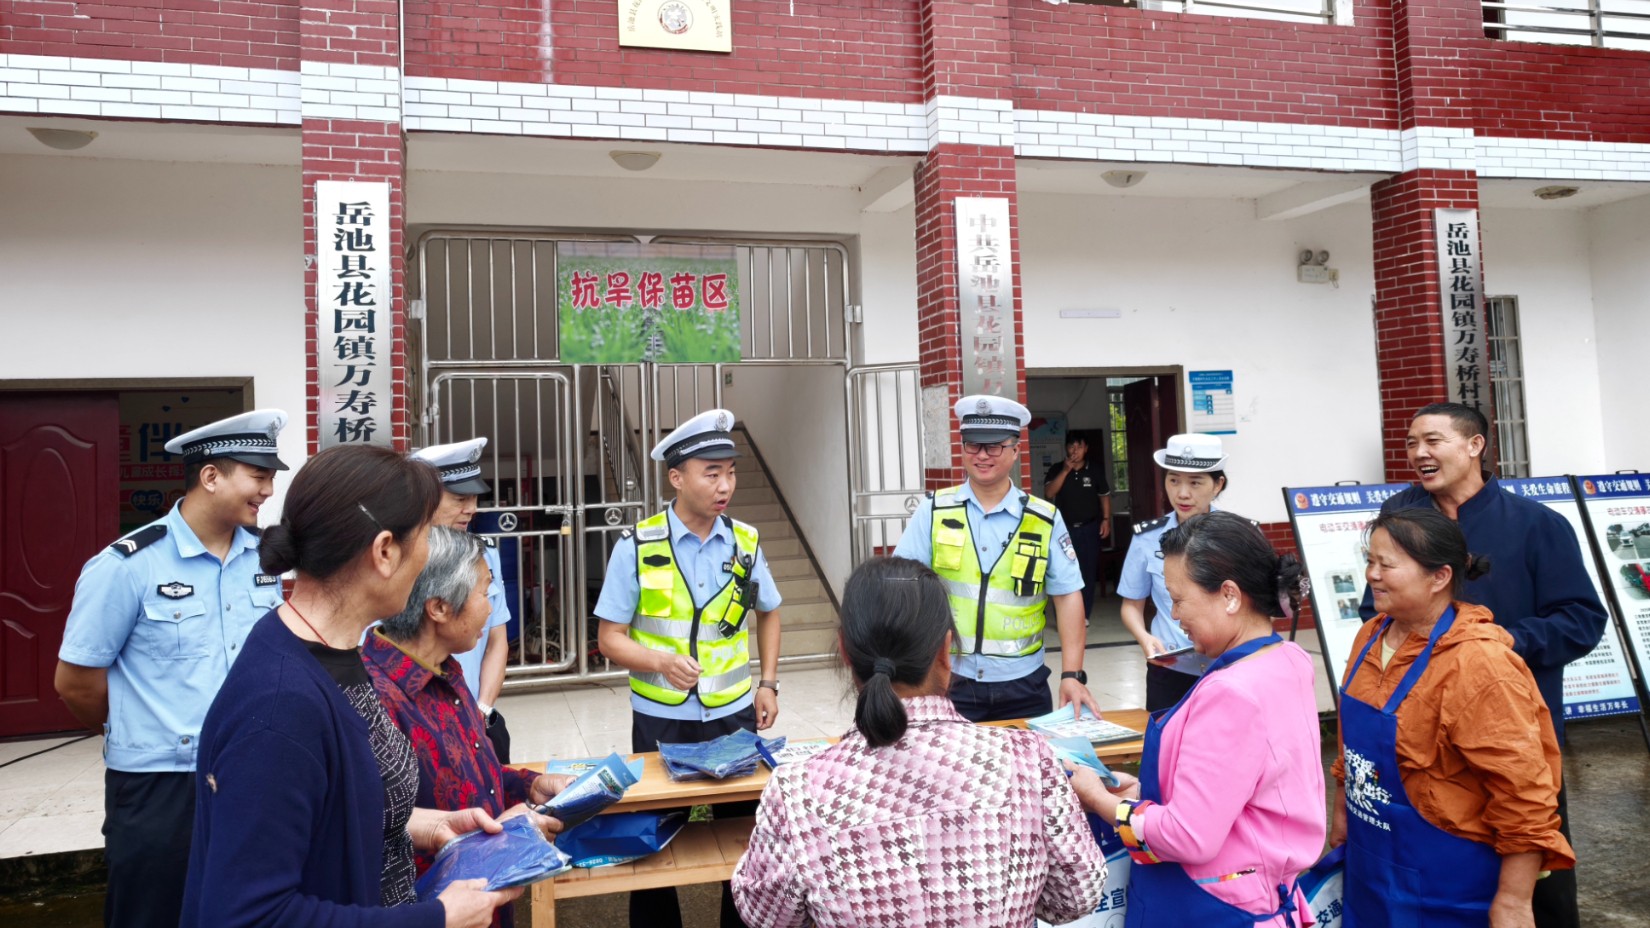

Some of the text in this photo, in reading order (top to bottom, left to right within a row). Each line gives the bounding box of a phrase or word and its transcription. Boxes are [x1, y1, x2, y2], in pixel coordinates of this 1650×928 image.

[571, 271, 728, 309] 抗旱保苗区
[332, 201, 377, 442] 岳池县花园镇万寿桥
[1095, 888, 1128, 913] 全宣
[1316, 897, 1343, 928] 交通
